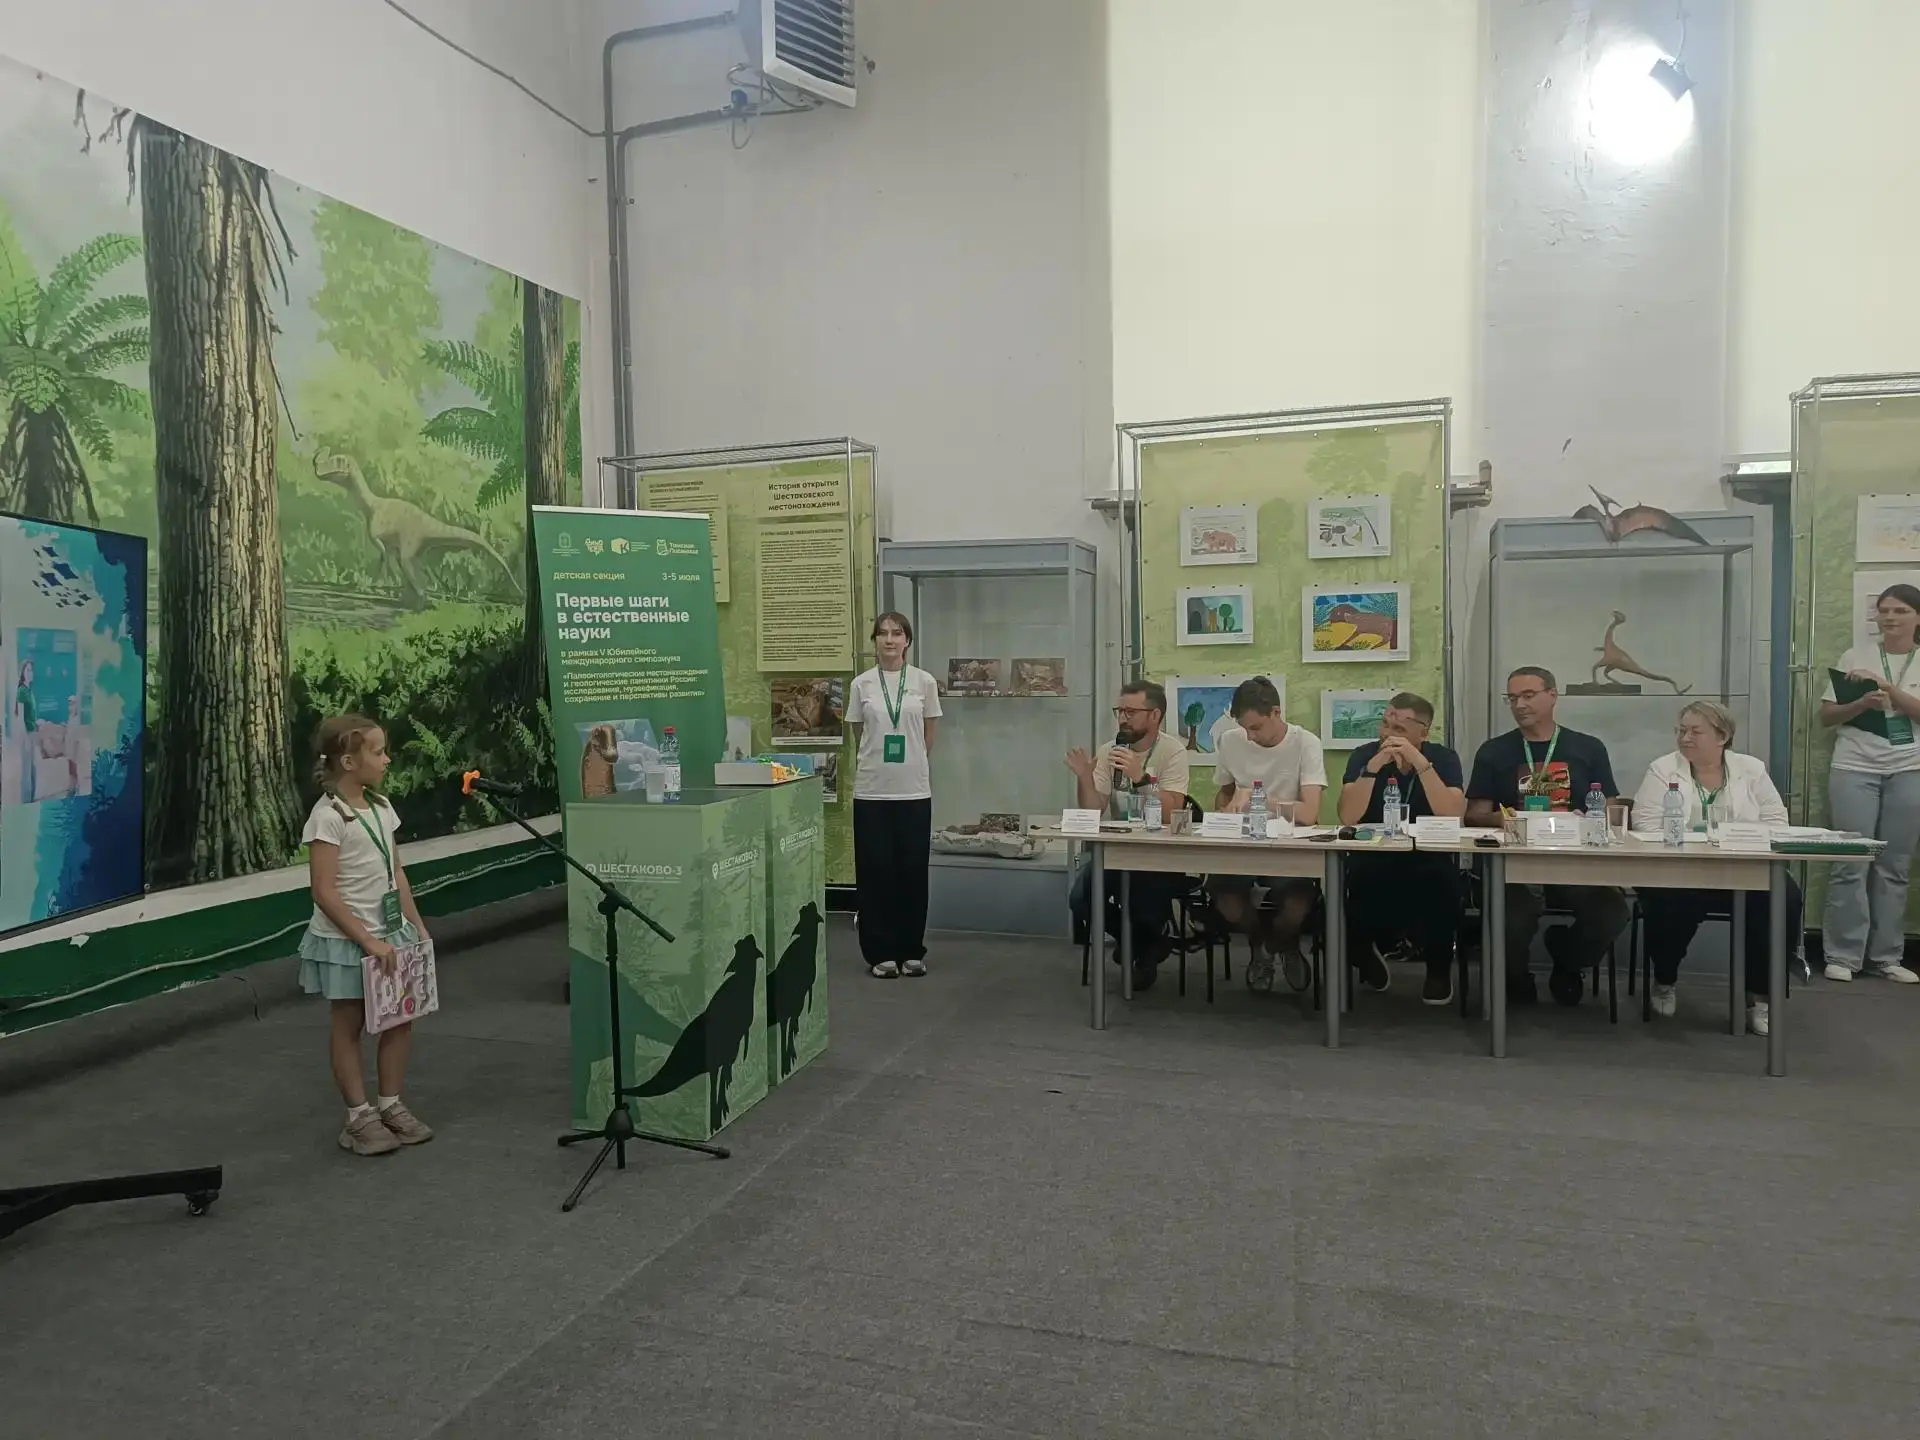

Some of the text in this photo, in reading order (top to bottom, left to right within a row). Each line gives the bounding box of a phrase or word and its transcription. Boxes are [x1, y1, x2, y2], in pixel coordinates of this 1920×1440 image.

[768, 480, 839, 492] История открытия
[773, 490, 835, 501] Шестаковского
[768, 500, 840, 511] местонахождения
[553, 571, 625, 581] детская секция
[662, 572, 677, 581] 3-5
[555, 592, 669, 611] Первые шаги
[557, 611, 690, 624] в естественные
[558, 627, 611, 643] науки
[568, 650, 599, 658] рамках
[606, 648, 657, 656] Юбилейного
[561, 655, 681, 666] международного симпозиума
[570, 679, 628, 687] геологические
[564, 694, 612, 703] сохранение
[619, 691, 668, 701] перспективы
[599, 863, 682, 876] ШЕСТАКОВО-3
